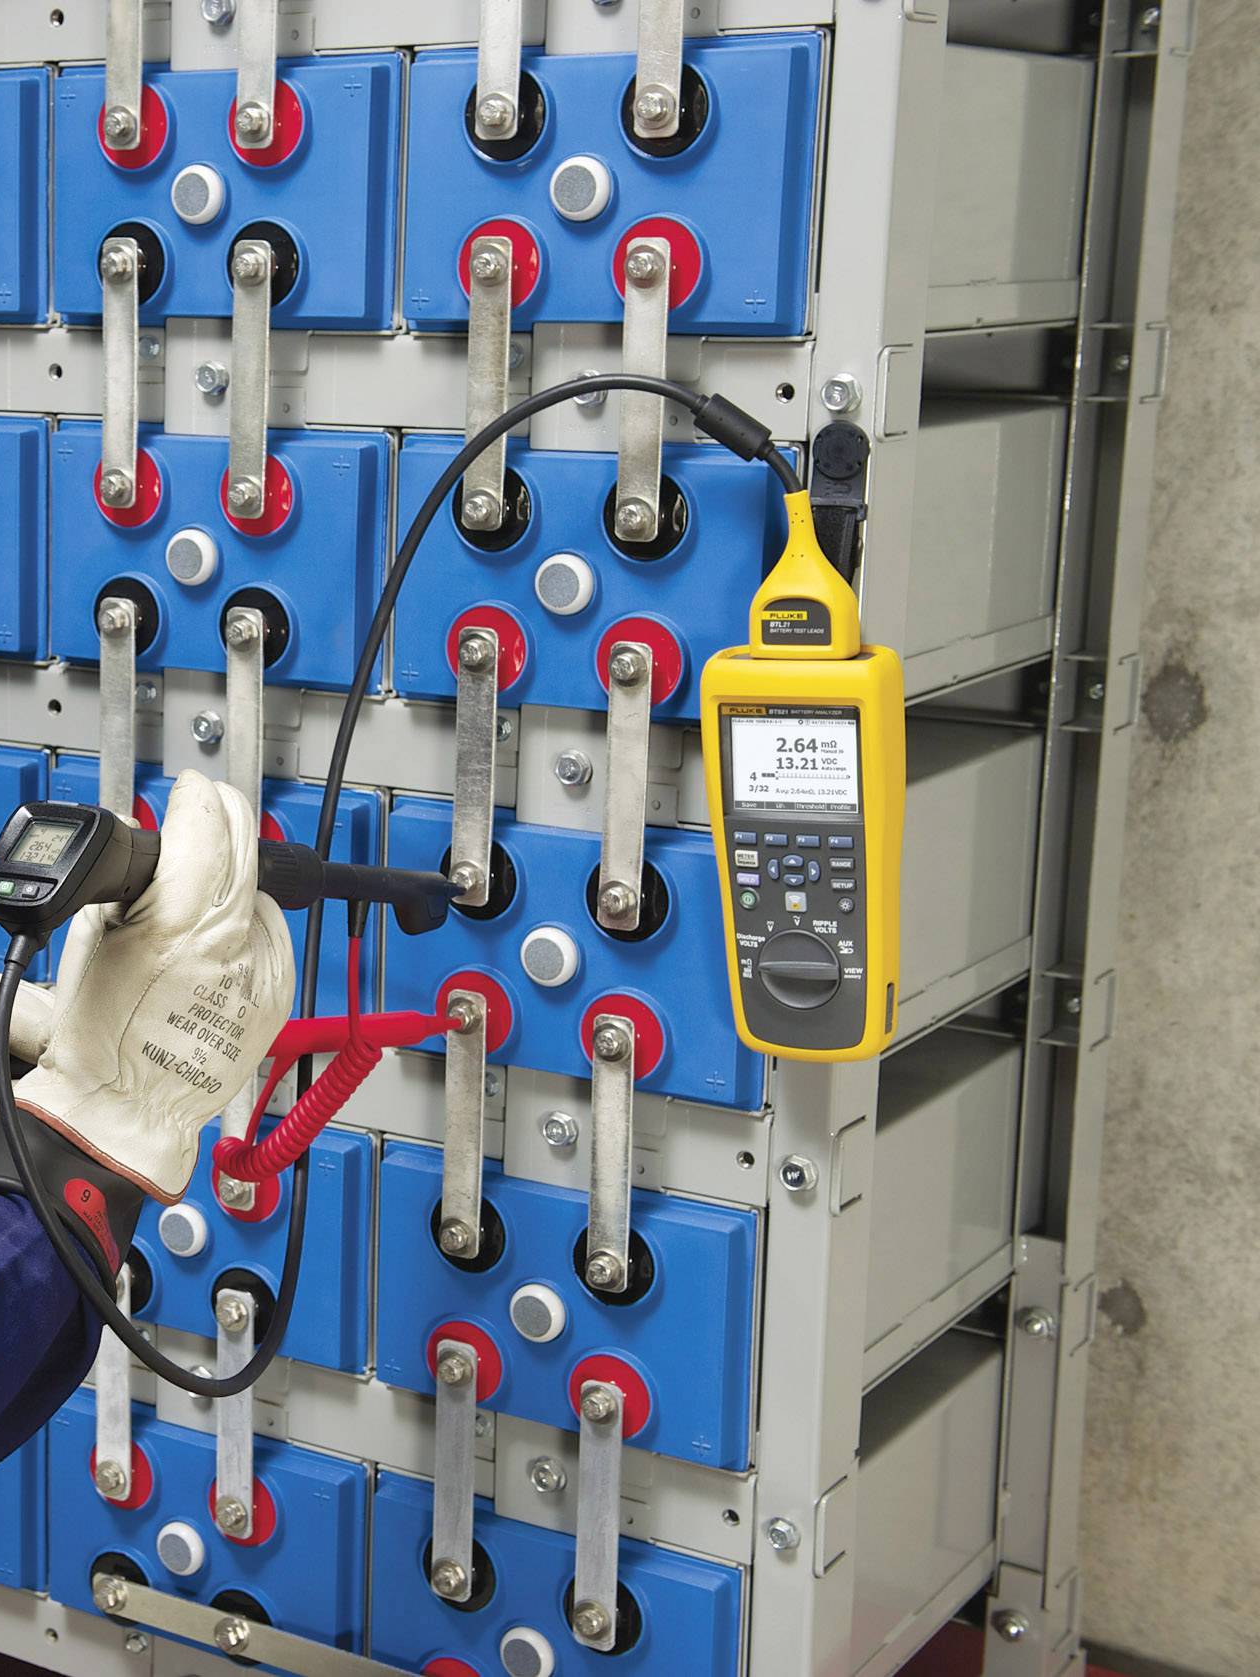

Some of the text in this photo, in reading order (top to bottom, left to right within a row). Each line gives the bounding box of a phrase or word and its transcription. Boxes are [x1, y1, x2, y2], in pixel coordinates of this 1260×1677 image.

[776, 737, 837, 753] 2.64 mΩ
[776, 757, 818, 770] 13.21
[749, 772, 757, 781] 4
[748, 784, 769, 793] 3/32
[814, 926, 837, 934] VOLTS
[736, 933, 766, 942] Discharge
[739, 940, 758, 948] VOLTS
[219, 974, 233, 990] 10
[193, 984, 229, 1009] CLASS
[188, 1002, 245, 1041] PROTECTOR
[167, 1011, 242, 1063] WEAR OVER SIZE
[141, 1040, 222, 1094] KUNZ-CHICAGO
